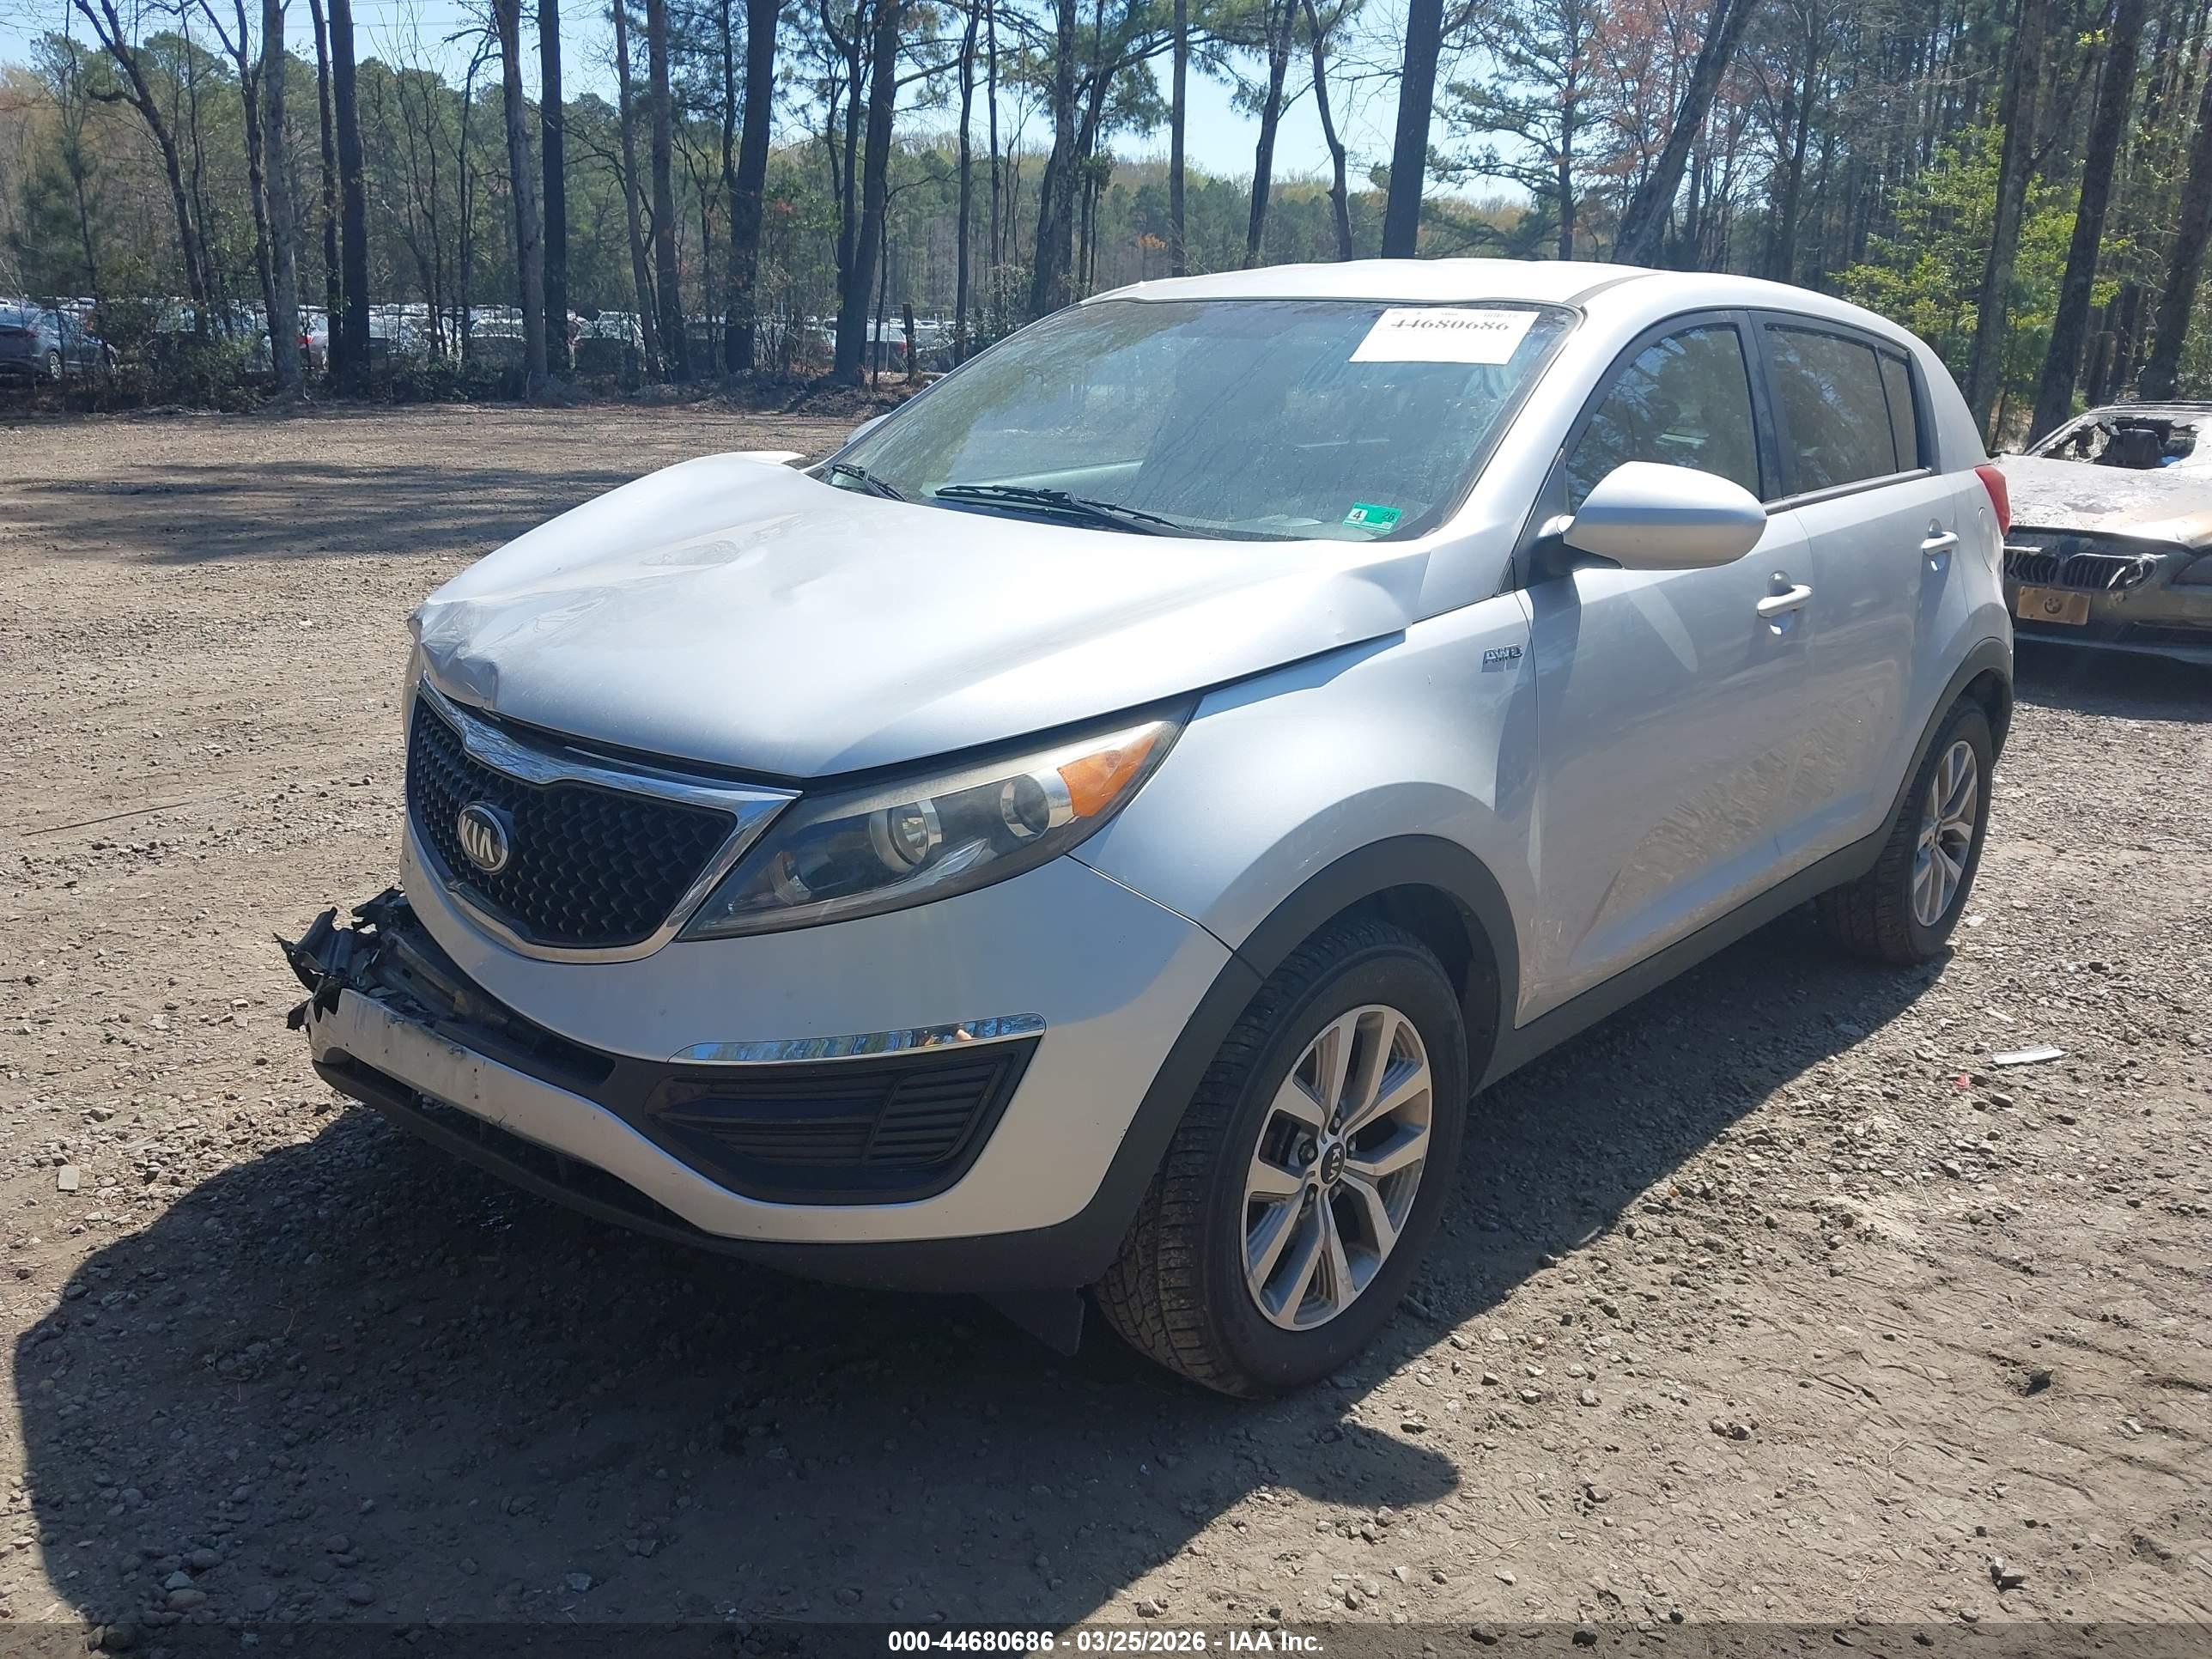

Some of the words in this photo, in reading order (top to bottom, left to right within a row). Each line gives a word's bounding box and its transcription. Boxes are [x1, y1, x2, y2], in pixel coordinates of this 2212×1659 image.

[1390, 319, 1510, 331] 44680686
[1352, 510, 1363, 520] 4
[1328, 1147, 1340, 1181] KIA
